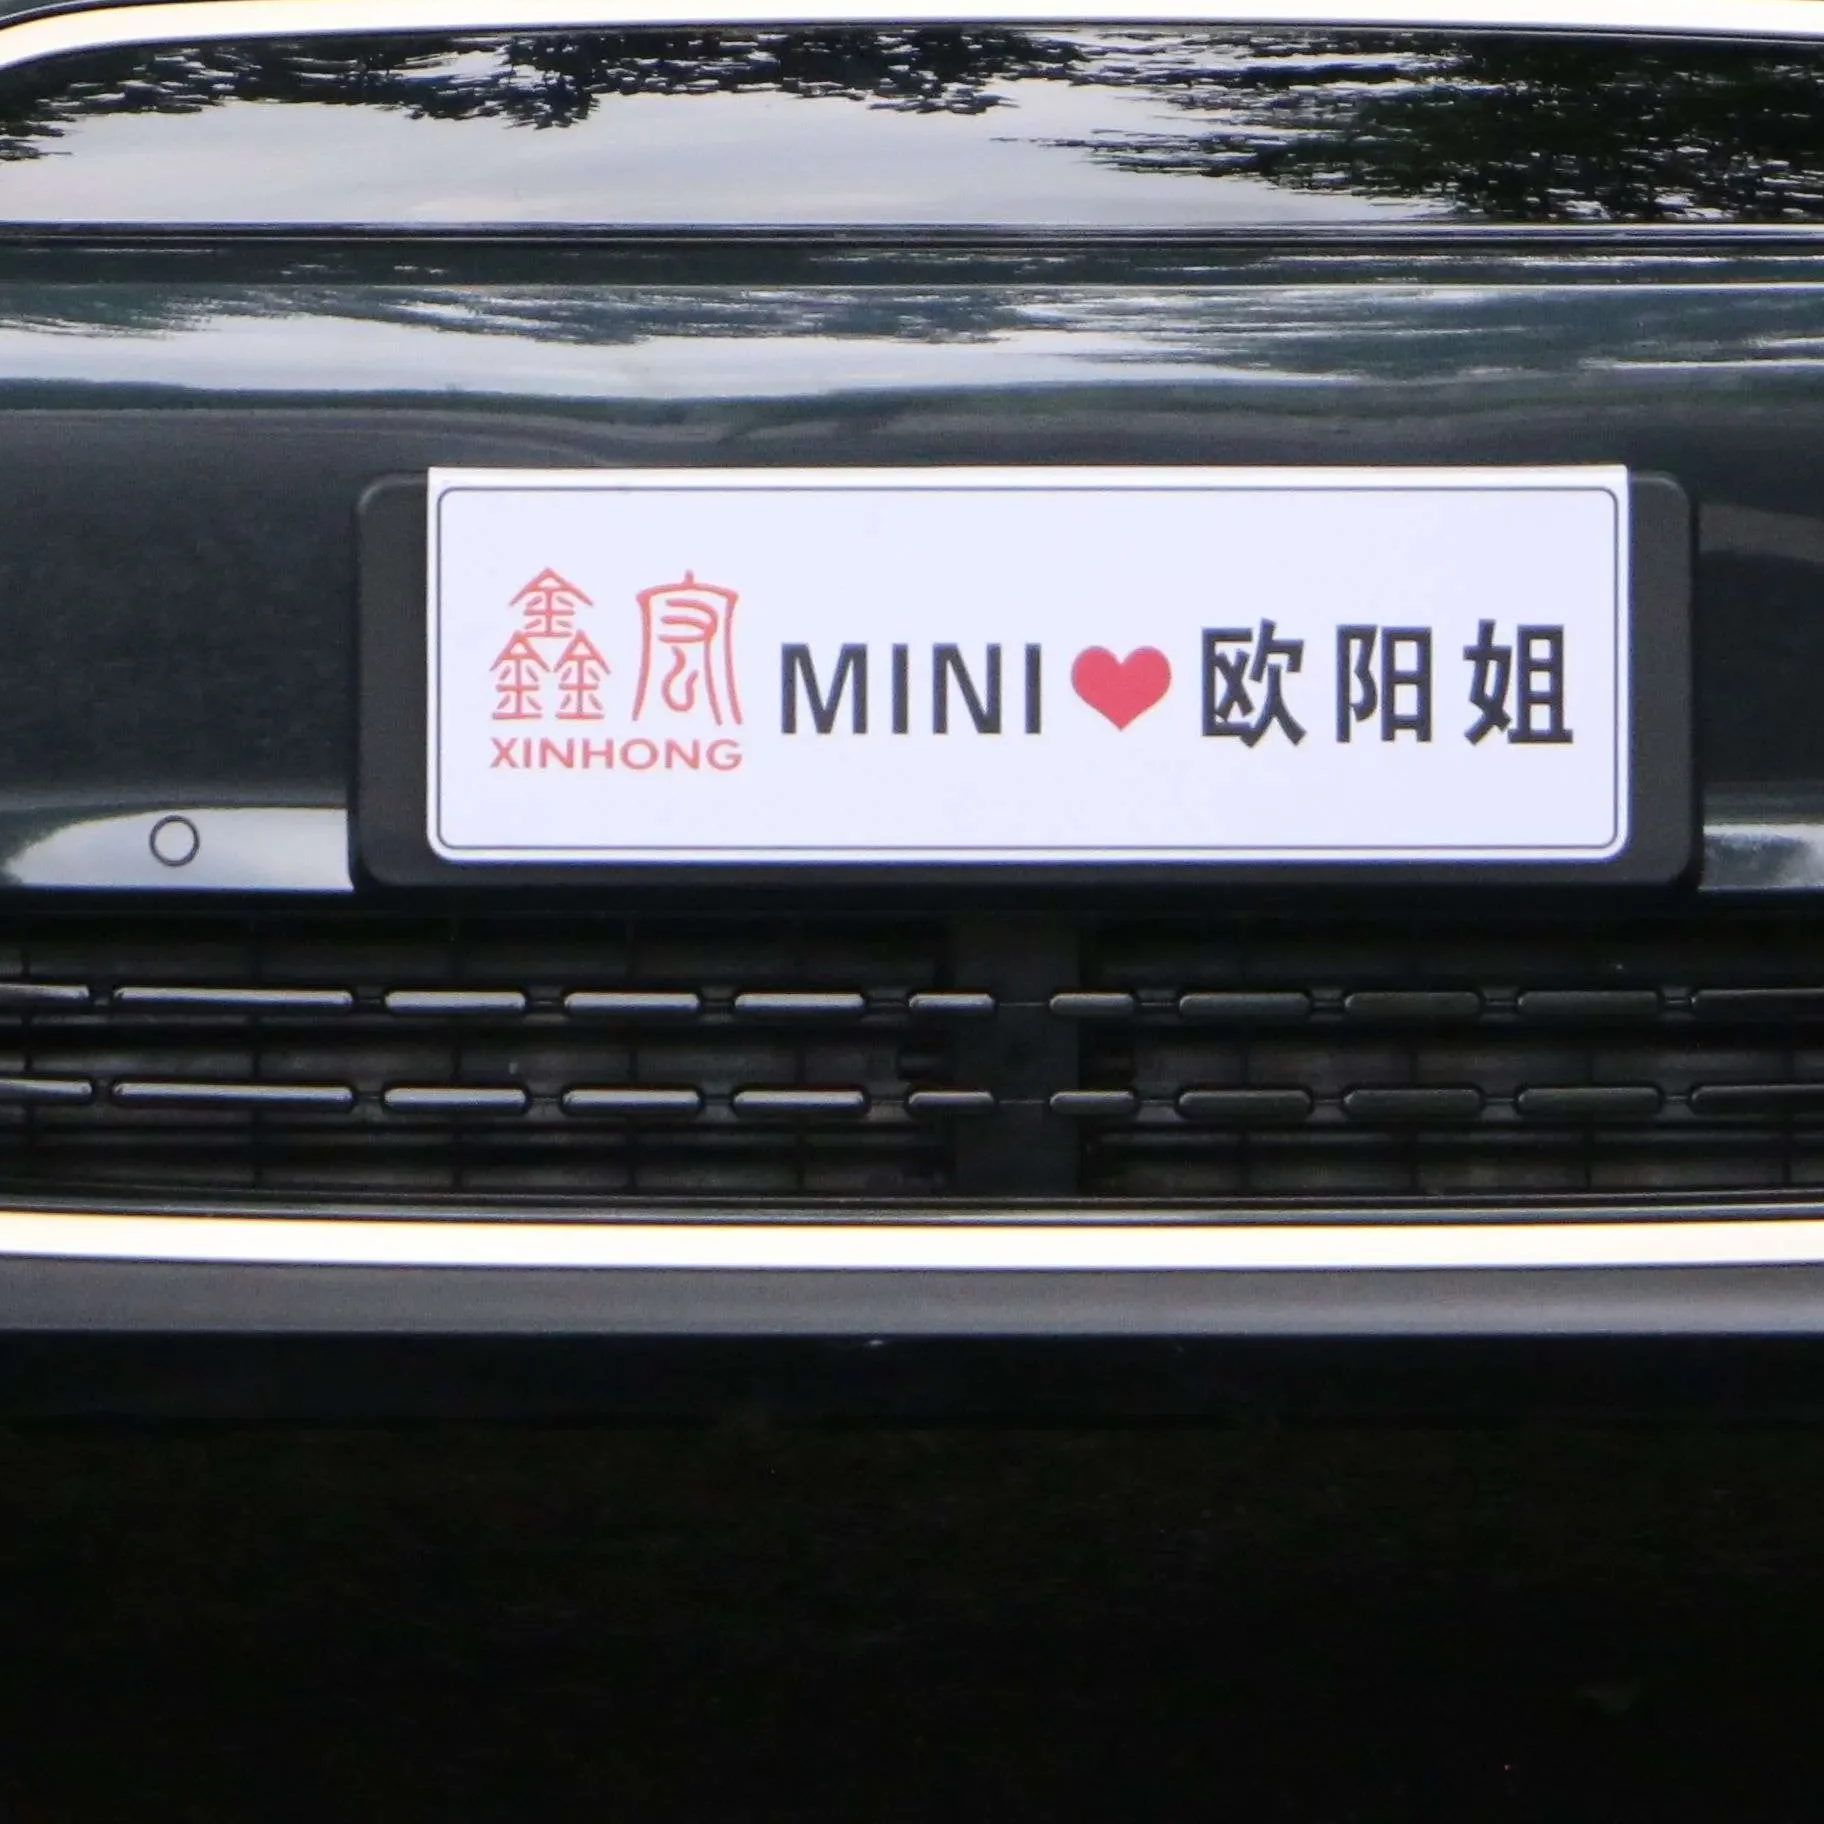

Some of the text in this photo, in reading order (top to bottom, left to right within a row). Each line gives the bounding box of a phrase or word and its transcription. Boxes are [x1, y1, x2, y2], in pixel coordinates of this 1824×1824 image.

[781, 618, 1574, 748] MINI 欧阳姐
[490, 737, 743, 771] XINHONG
